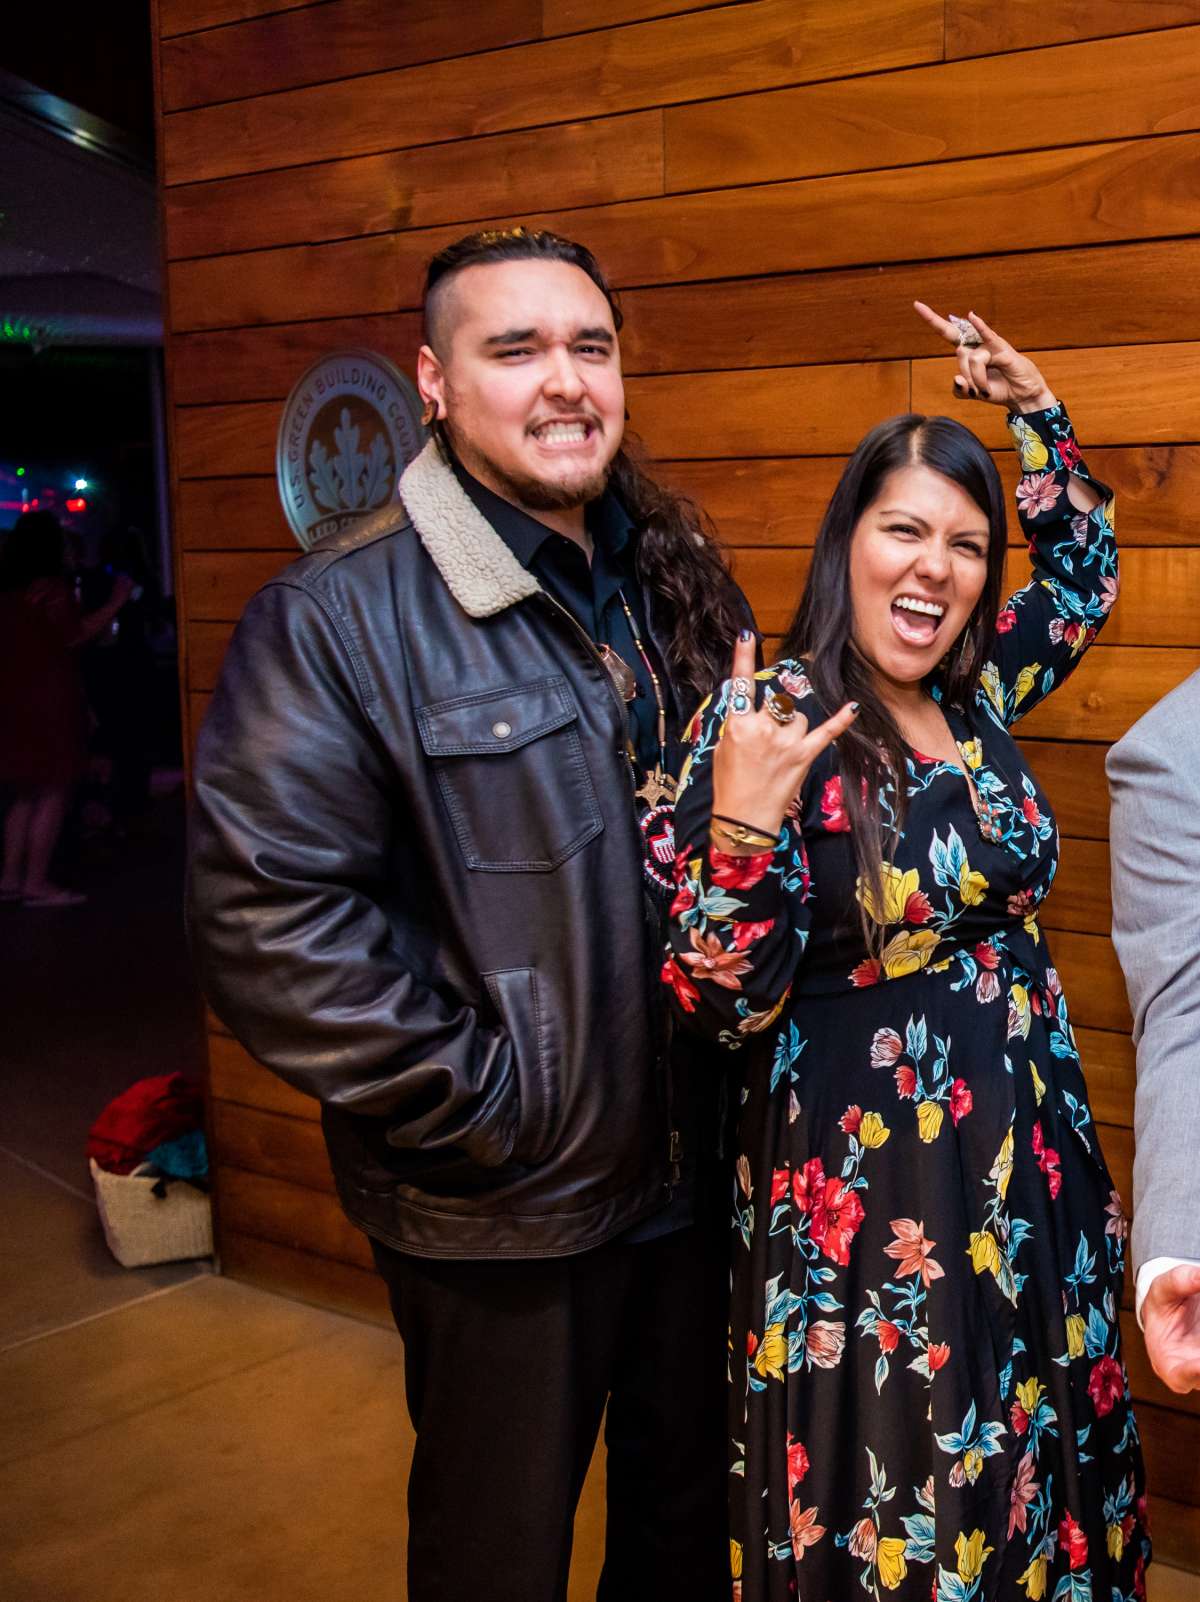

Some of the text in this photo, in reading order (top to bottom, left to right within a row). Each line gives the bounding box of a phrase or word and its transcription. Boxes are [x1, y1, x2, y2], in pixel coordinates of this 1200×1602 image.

[288, 392, 316, 463] GREEN
[316, 367, 388, 402] BUILDING
[387, 402, 414, 464] COUN
[309, 519, 338, 542] LEED
